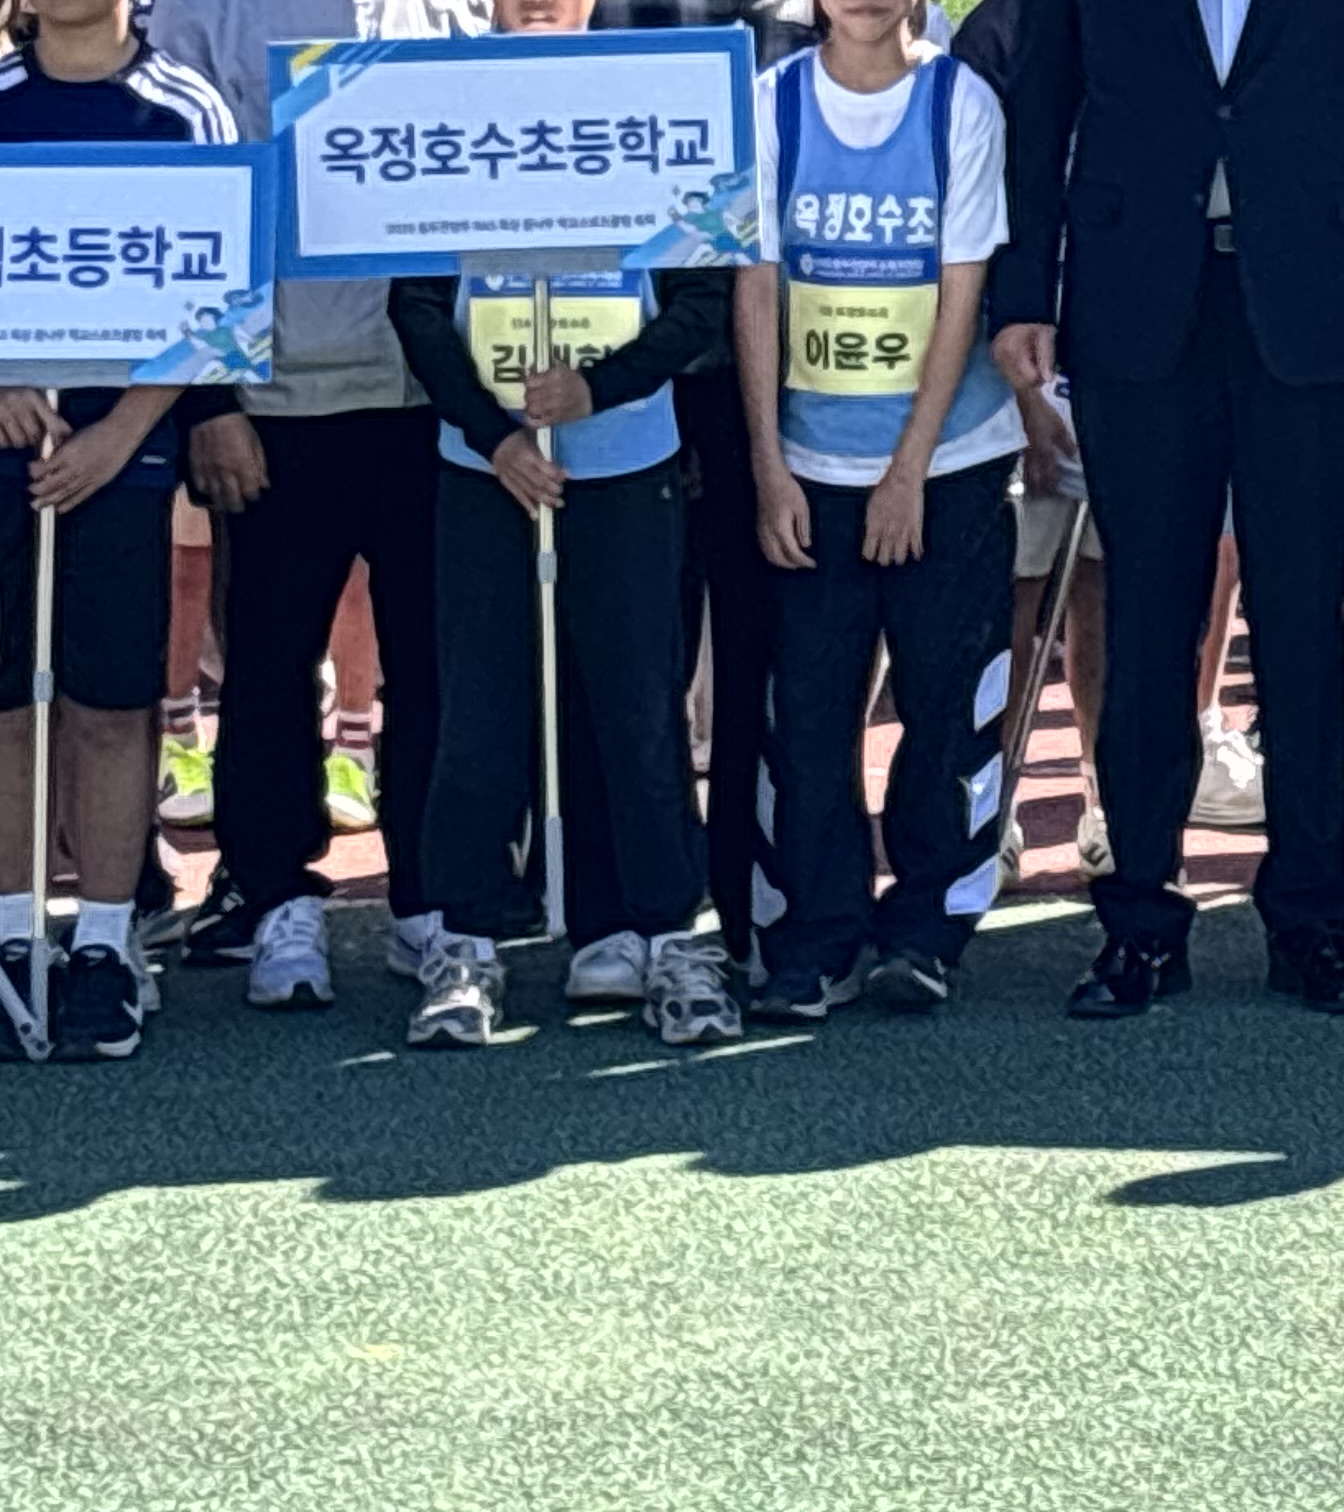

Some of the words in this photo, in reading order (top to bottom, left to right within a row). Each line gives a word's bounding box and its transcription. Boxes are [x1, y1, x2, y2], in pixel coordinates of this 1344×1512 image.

[319, 113, 716, 185] 옥정호수초등학교
[0, 225, 228, 290] 초등학교
[805, 327, 912, 371] 이윤우
